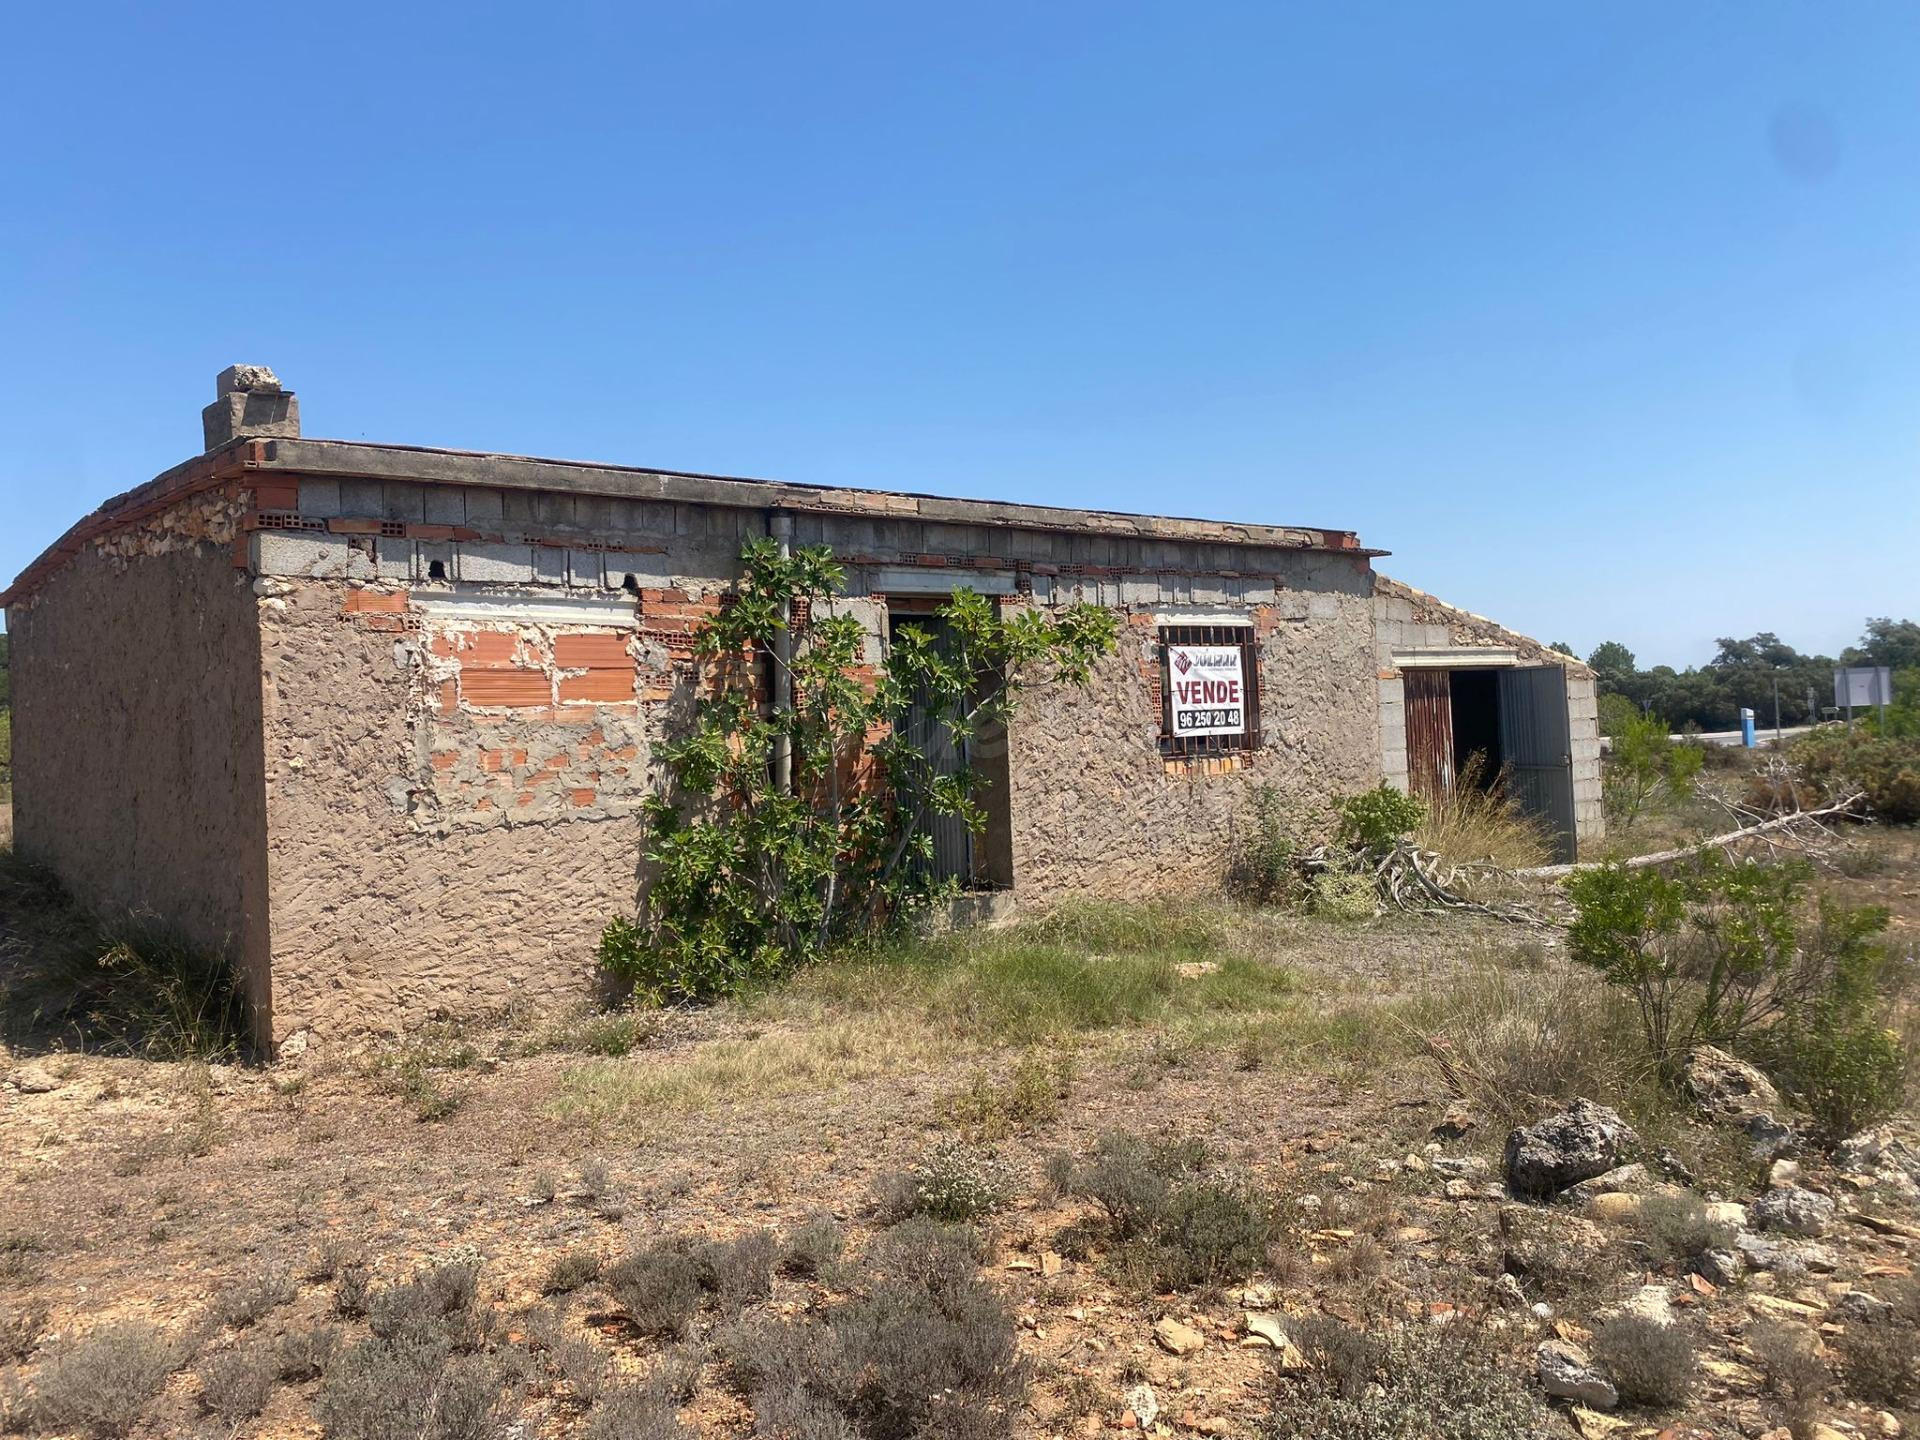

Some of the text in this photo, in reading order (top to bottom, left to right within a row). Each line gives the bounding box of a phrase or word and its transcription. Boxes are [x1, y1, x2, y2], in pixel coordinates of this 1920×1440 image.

[1177, 680, 1239, 704] VENDE
[1180, 710, 1239, 727] 96 250 20 48
